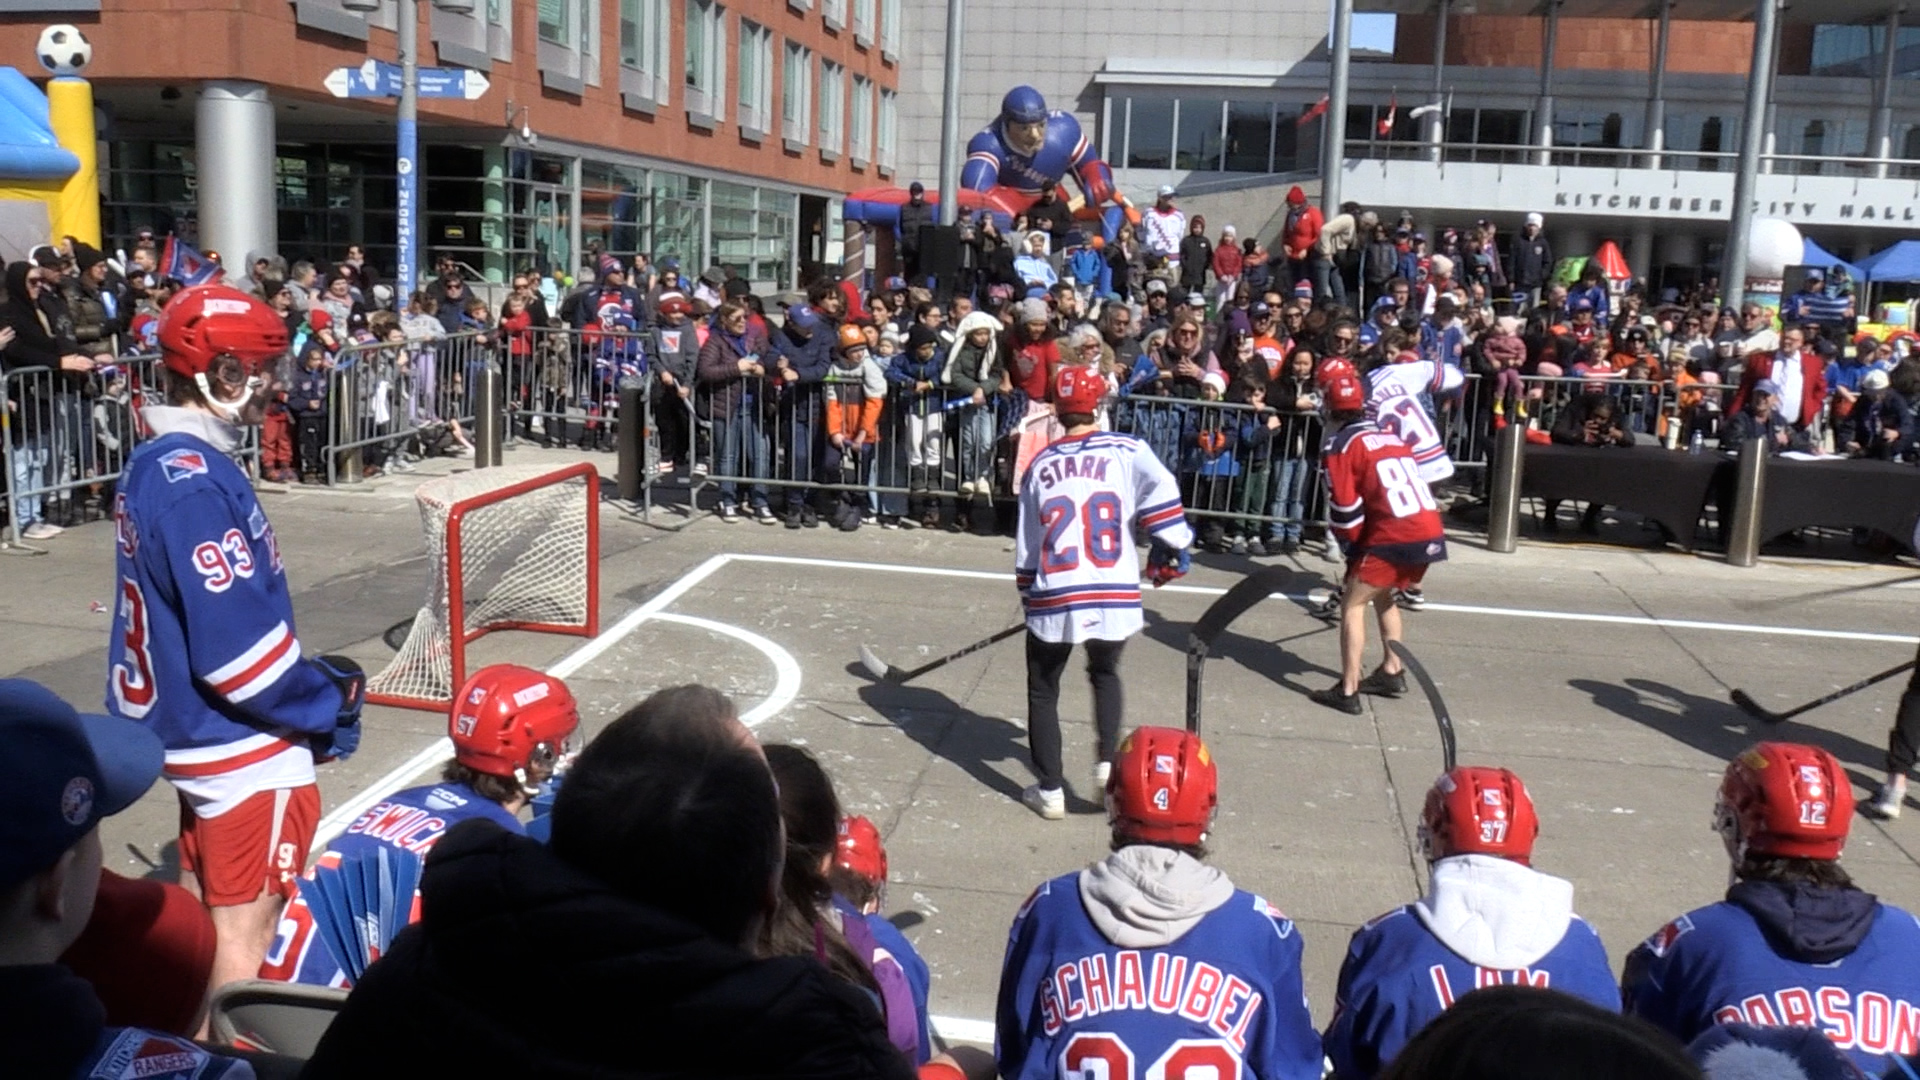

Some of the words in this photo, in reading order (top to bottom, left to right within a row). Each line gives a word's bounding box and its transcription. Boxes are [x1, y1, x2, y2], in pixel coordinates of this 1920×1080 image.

[1554, 192, 1723, 213] KITCHENER
[1839, 203, 1915, 221] HALL
[398, 178, 410, 282] INFORMATION
[1039, 454, 1113, 490] STARK
[1040, 490, 1123, 574] 28
[191, 528, 255, 593] 93
[1153, 787, 1169, 811] 4
[1799, 800, 1827, 825] 12
[1480, 819, 1508, 843] 37
[1040, 950, 1262, 1053] SCHAUBEL
[133, 1052, 198, 1076] RANGERS
